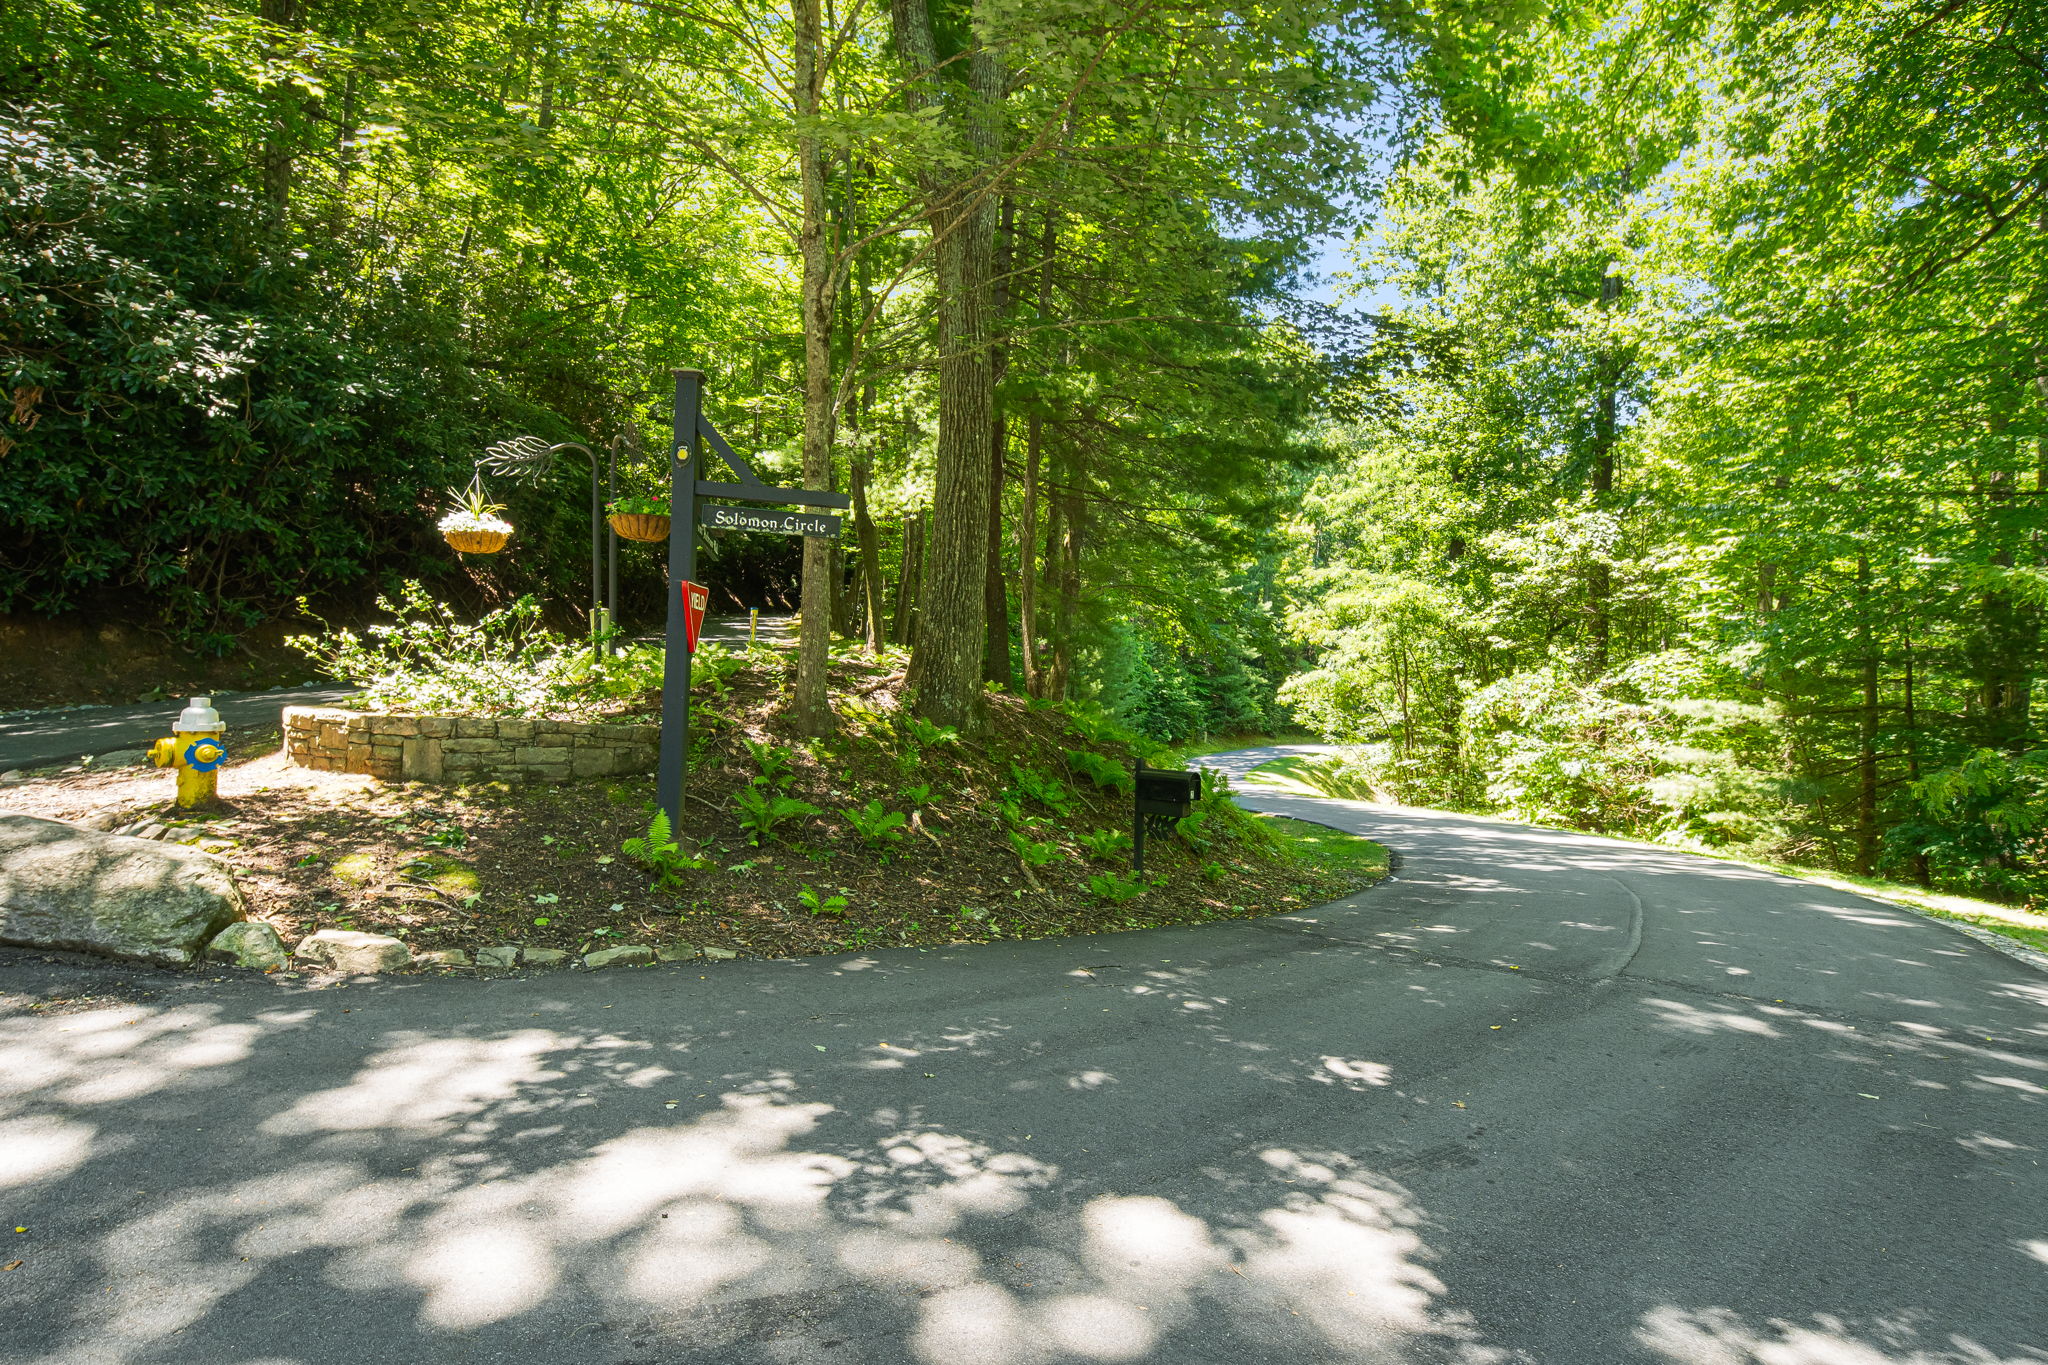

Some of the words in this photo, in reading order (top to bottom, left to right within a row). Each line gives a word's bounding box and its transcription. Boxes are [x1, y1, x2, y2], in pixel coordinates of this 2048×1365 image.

[715, 510, 778, 529] Solomon
[784, 516, 827, 533] Circle
[690, 591, 706, 611] YIELD
